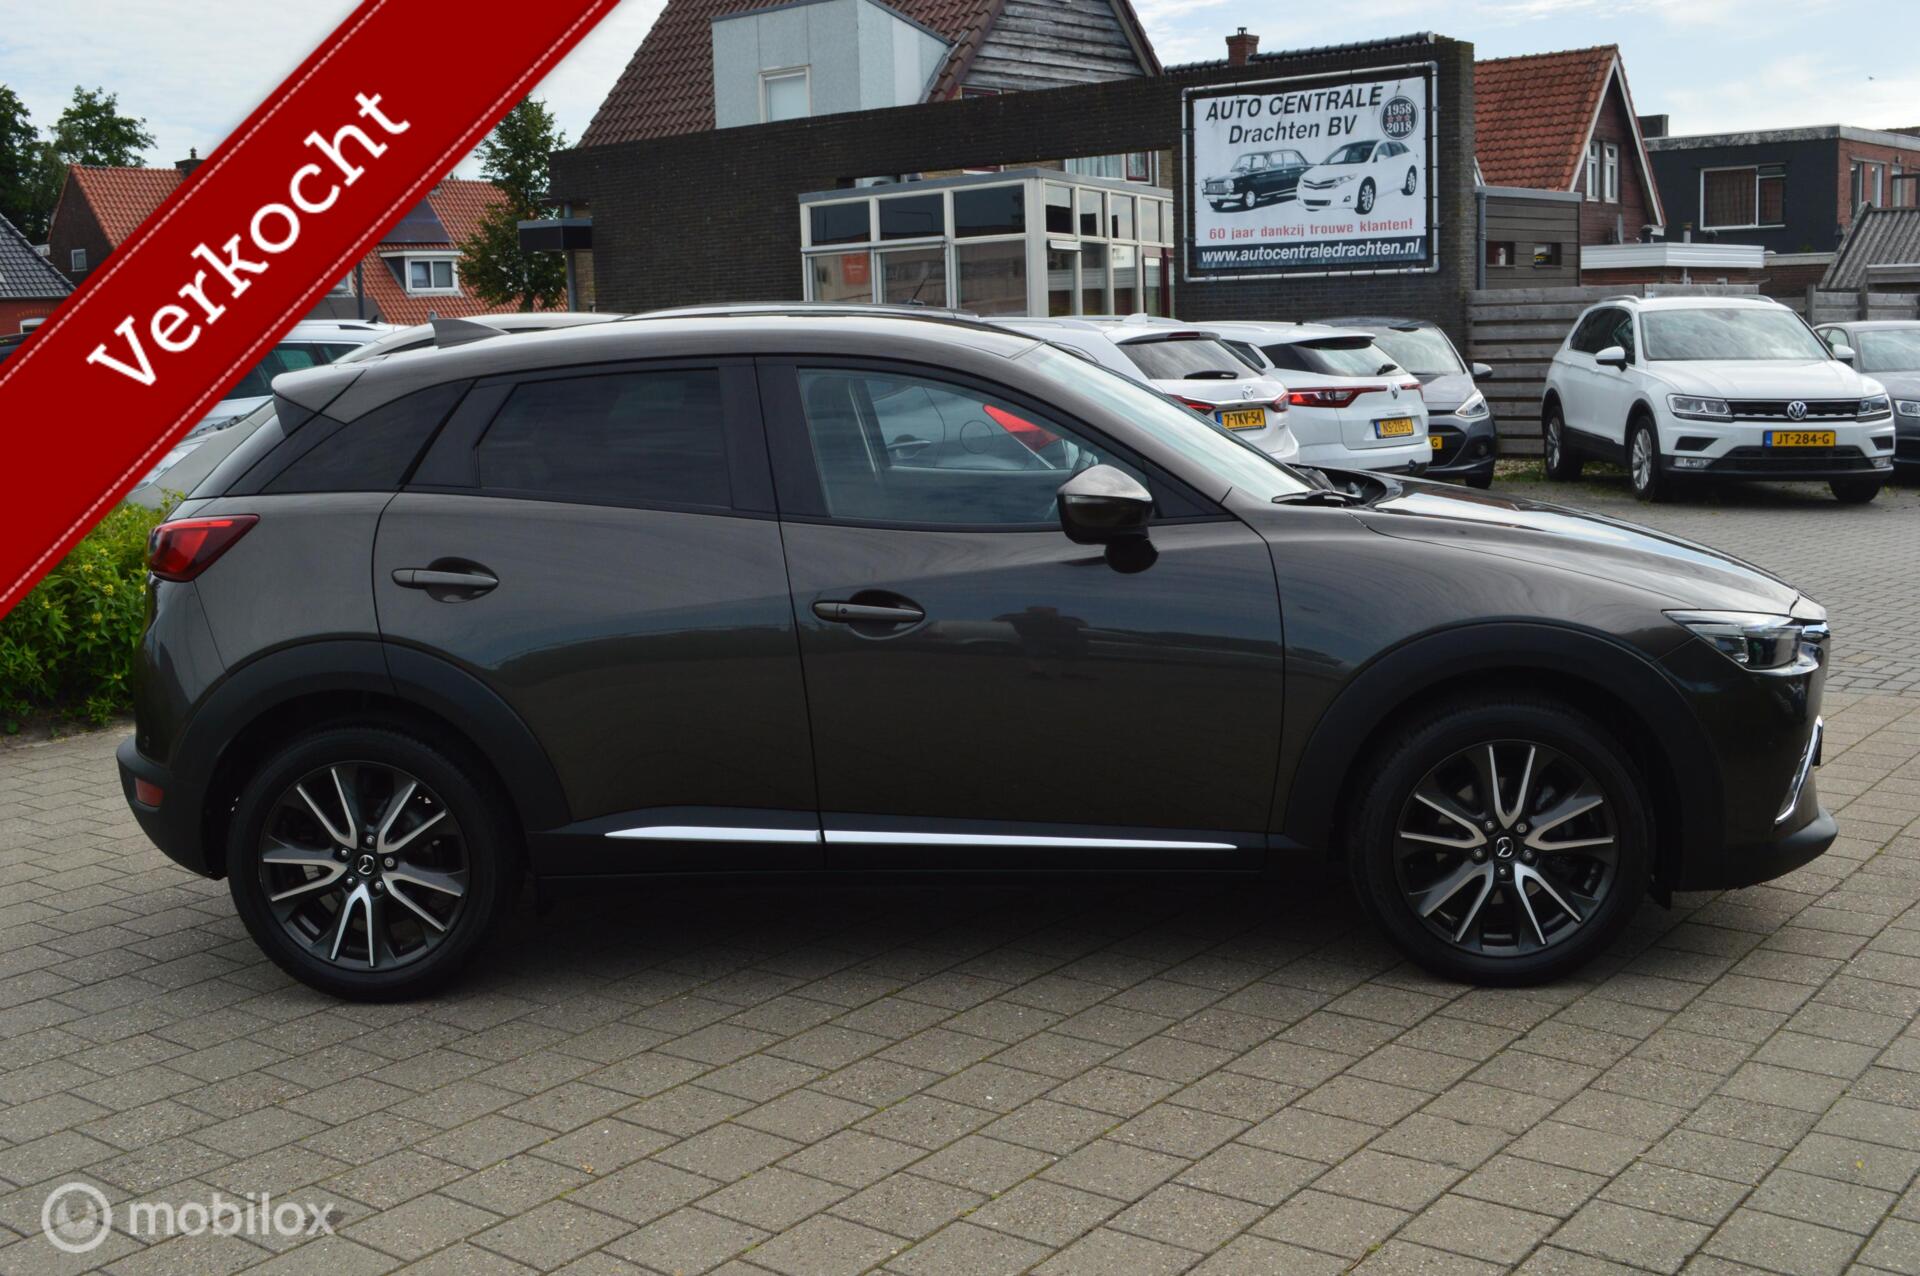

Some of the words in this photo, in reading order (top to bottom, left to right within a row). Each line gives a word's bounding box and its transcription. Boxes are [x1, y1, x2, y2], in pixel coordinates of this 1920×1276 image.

[1206, 97, 1262, 121] AUTO
[1269, 86, 1384, 116] CENTRALE
[1386, 102, 1412, 117] 1958
[1229, 121, 1321, 144] Drachten
[1327, 115, 1358, 137] BV
[1386, 121, 1412, 135] 2018
[1209, 227, 1226, 240] 60
[1231, 226, 1254, 240] jaar
[1260, 223, 1305, 238] dankzij
[1309, 220, 1353, 236] trouwe
[1359, 217, 1414, 232] klanten!
[1202, 238, 1421, 262] www.autocentraledrachten.nl
[1224, 411, 1262, 427] 7-TKV-54
[1776, 433, 1830, 445] JT-284-G
